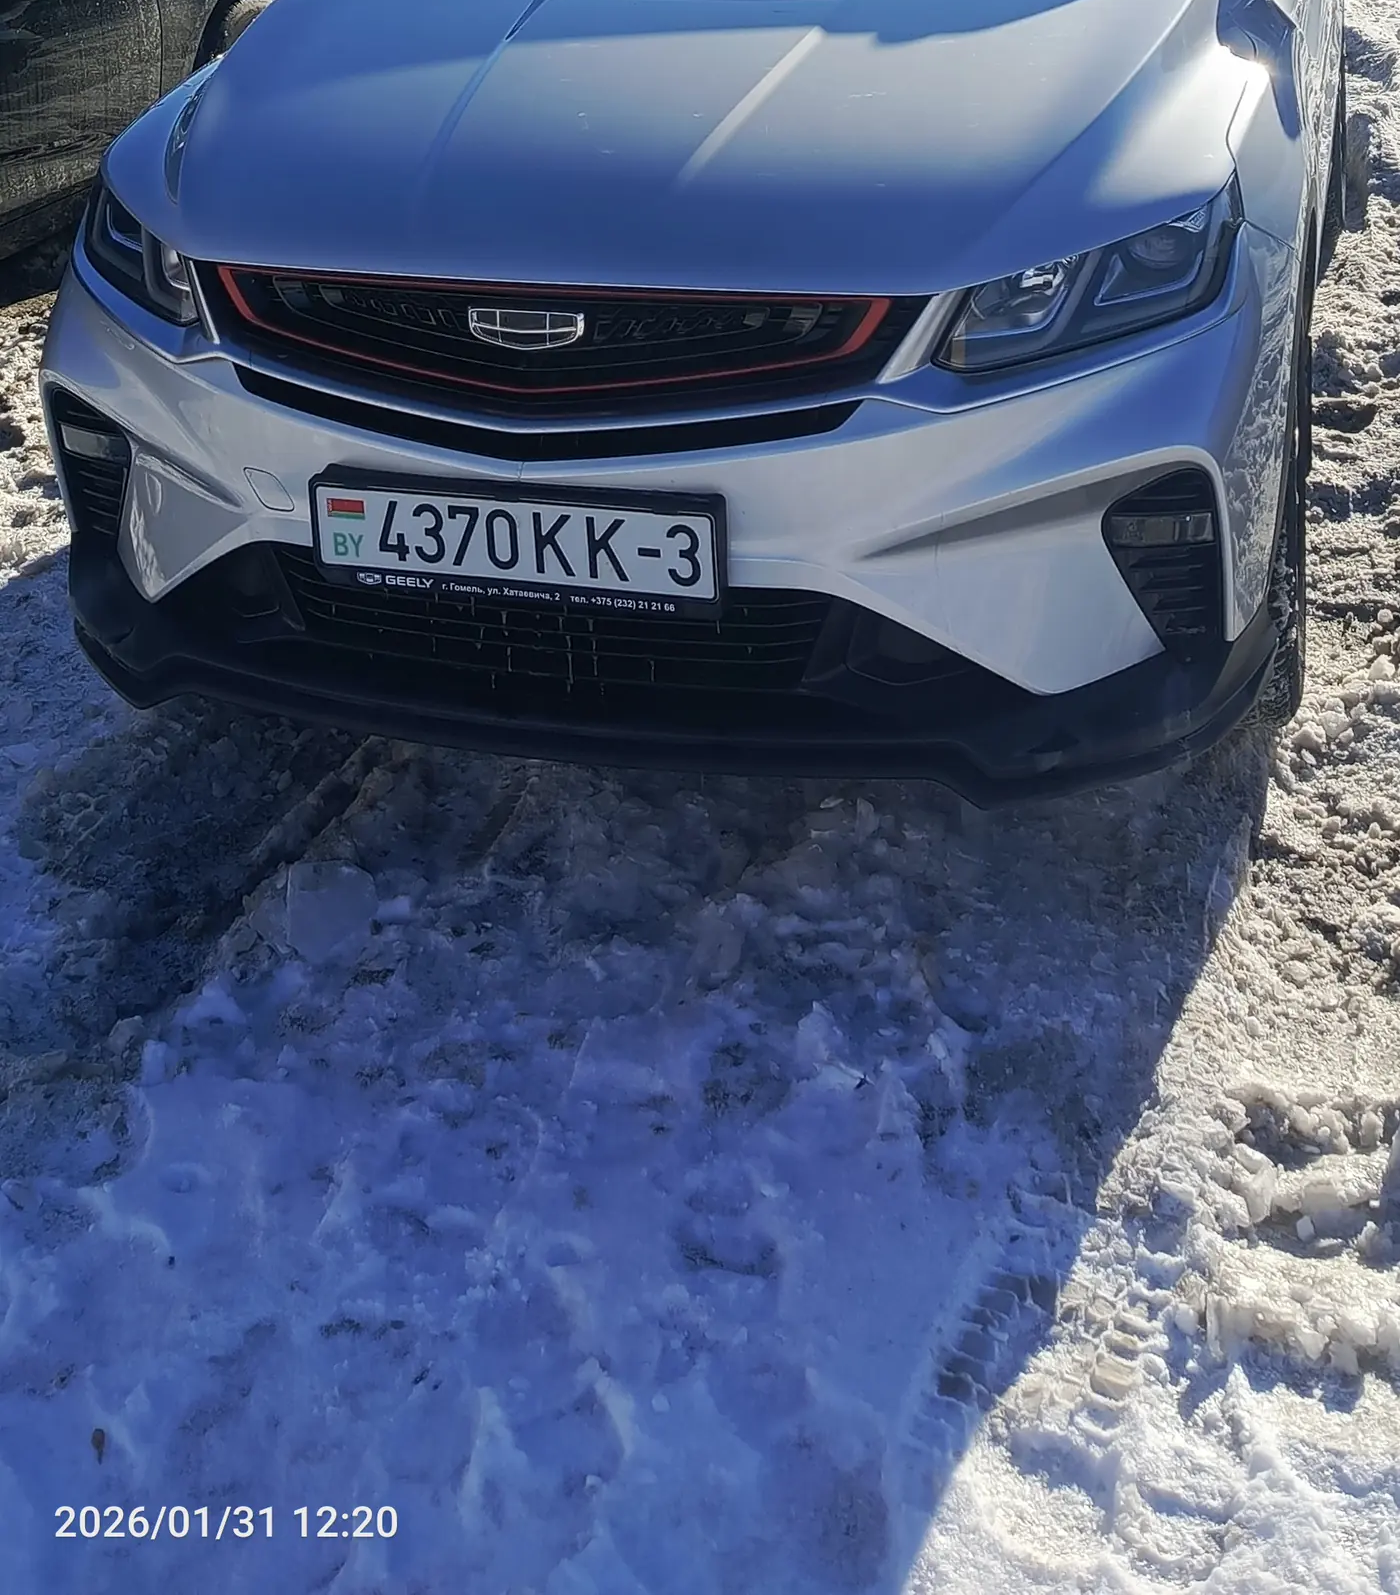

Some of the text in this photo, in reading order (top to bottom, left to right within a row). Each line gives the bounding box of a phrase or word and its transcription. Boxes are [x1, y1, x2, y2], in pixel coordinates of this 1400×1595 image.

[333, 532, 364, 558] BY
[385, 575, 434, 589] GEELY
[442, 583, 449, 591] г.
[450, 583, 486, 595] Гомель,
[487, 587, 501, 596] ул.
[554, 592, 561, 601] 2
[570, 595, 589, 604] тел.
[590, 596, 612, 606] +375
[614, 597, 636, 610] (232)
[638, 600, 649, 609] 21
[651, 601, 662, 610] 21
[664, 602, 675, 612] 66
